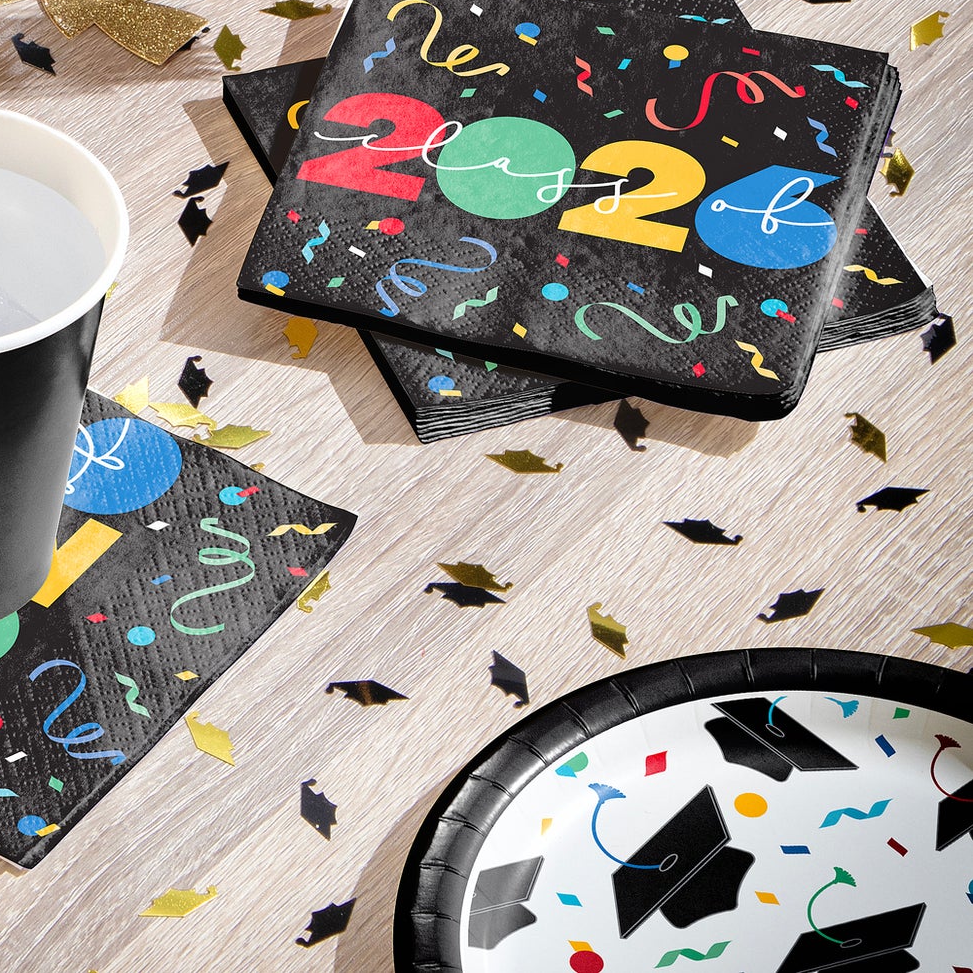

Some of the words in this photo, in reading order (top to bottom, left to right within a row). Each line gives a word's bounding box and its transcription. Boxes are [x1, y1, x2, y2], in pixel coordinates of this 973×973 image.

[296, 92, 841, 270] 2026
[313, 121, 678, 215] class
[710, 176, 836, 235] of
